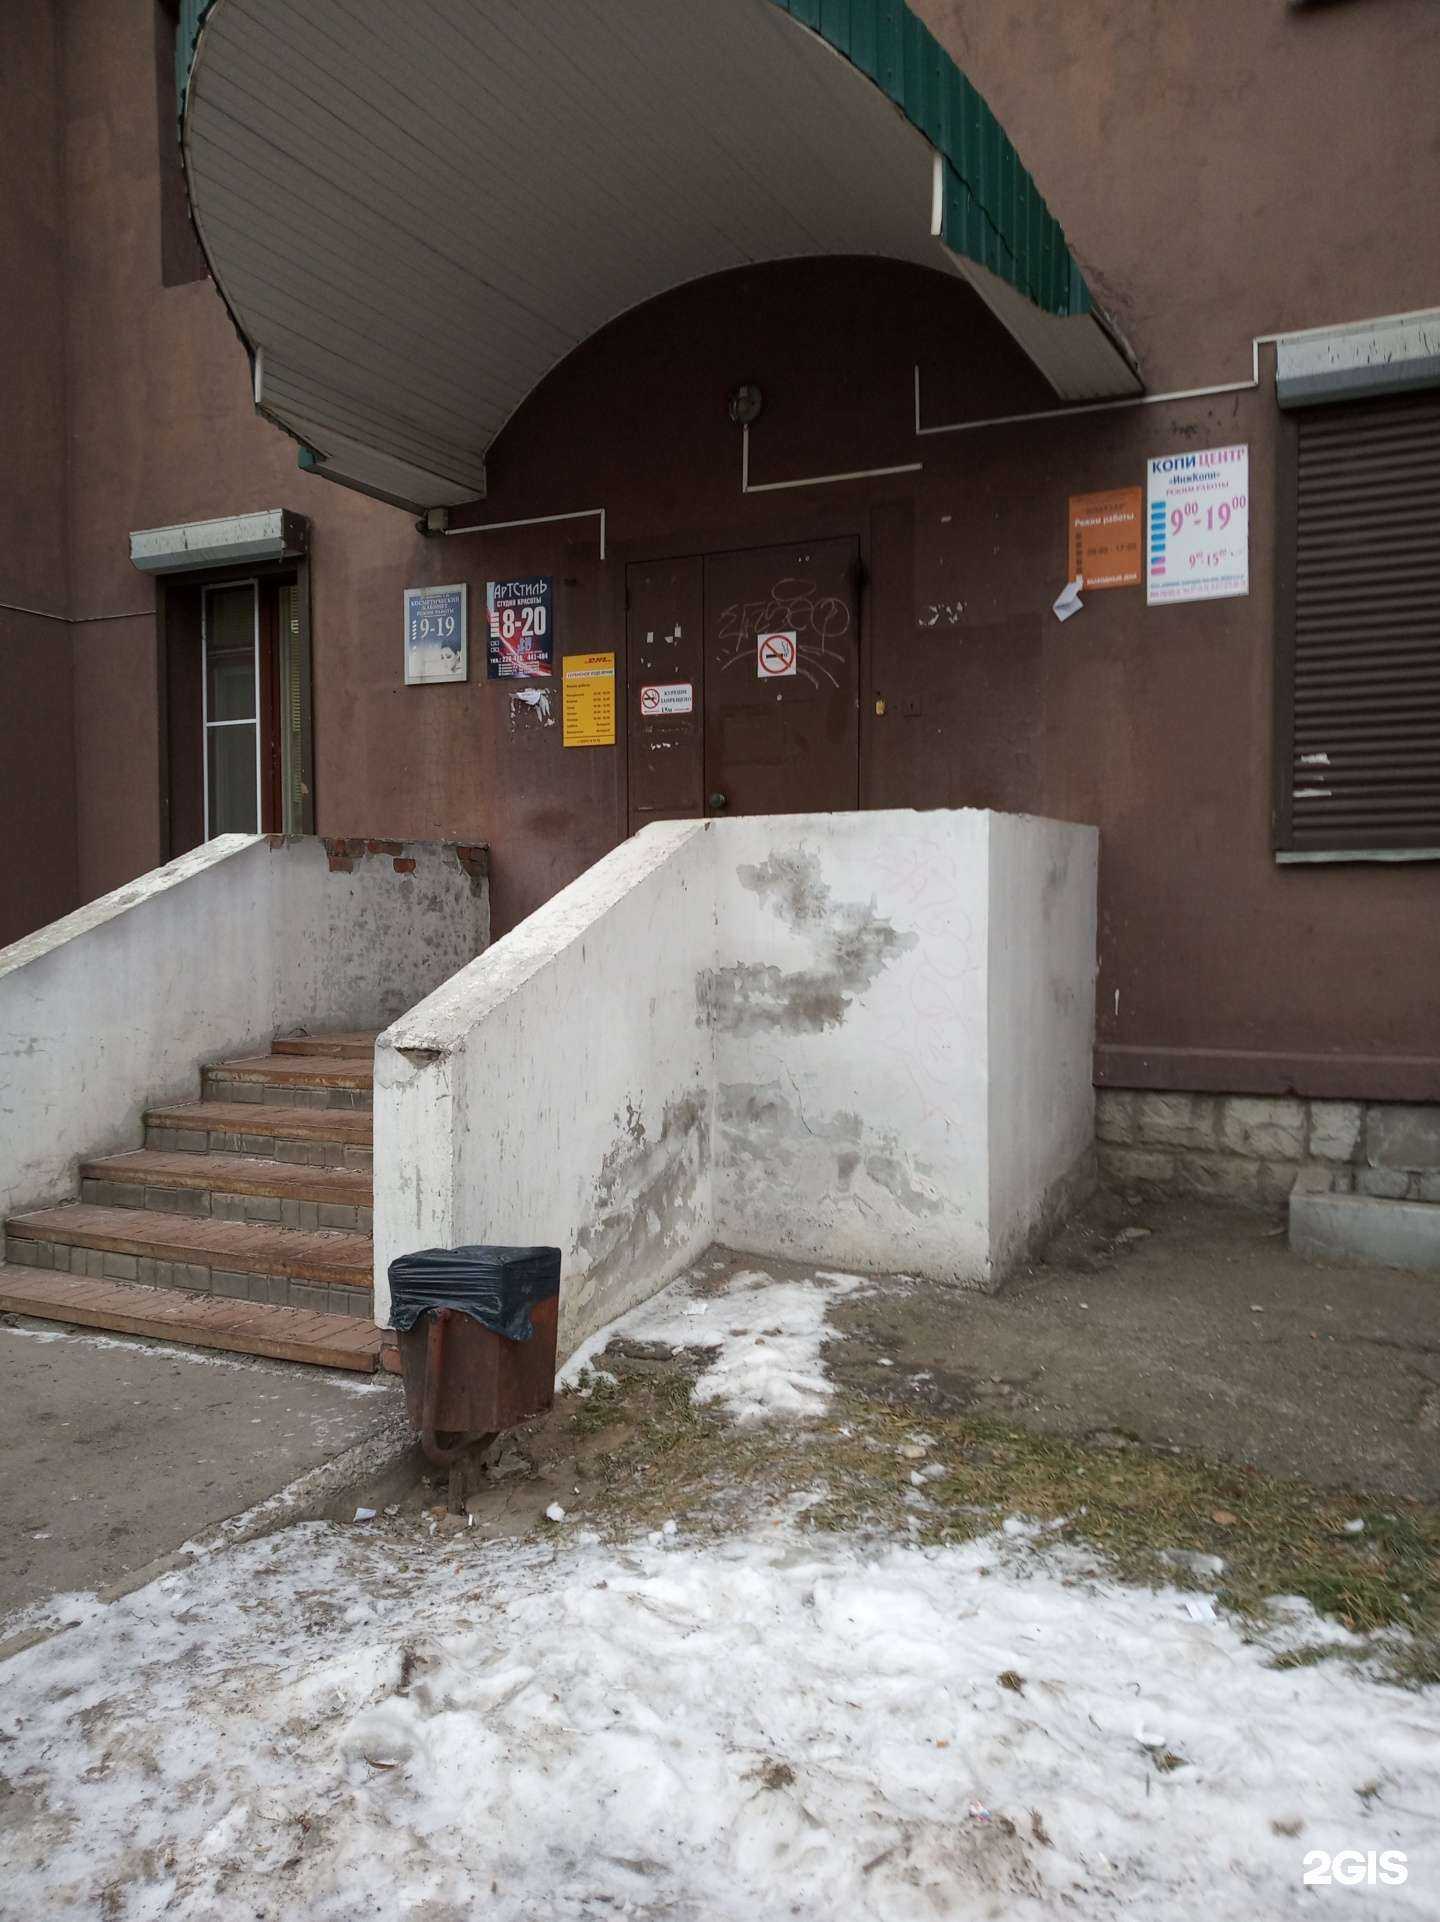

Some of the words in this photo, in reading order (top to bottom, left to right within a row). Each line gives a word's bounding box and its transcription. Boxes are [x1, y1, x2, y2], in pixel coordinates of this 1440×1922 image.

[1152, 456, 1196, 473] КОПИ
[1199, 448, 1245, 468] ЦЕНТР
[420, 616, 455, 639] 9-19
[502, 606, 546, 639] 8-20
